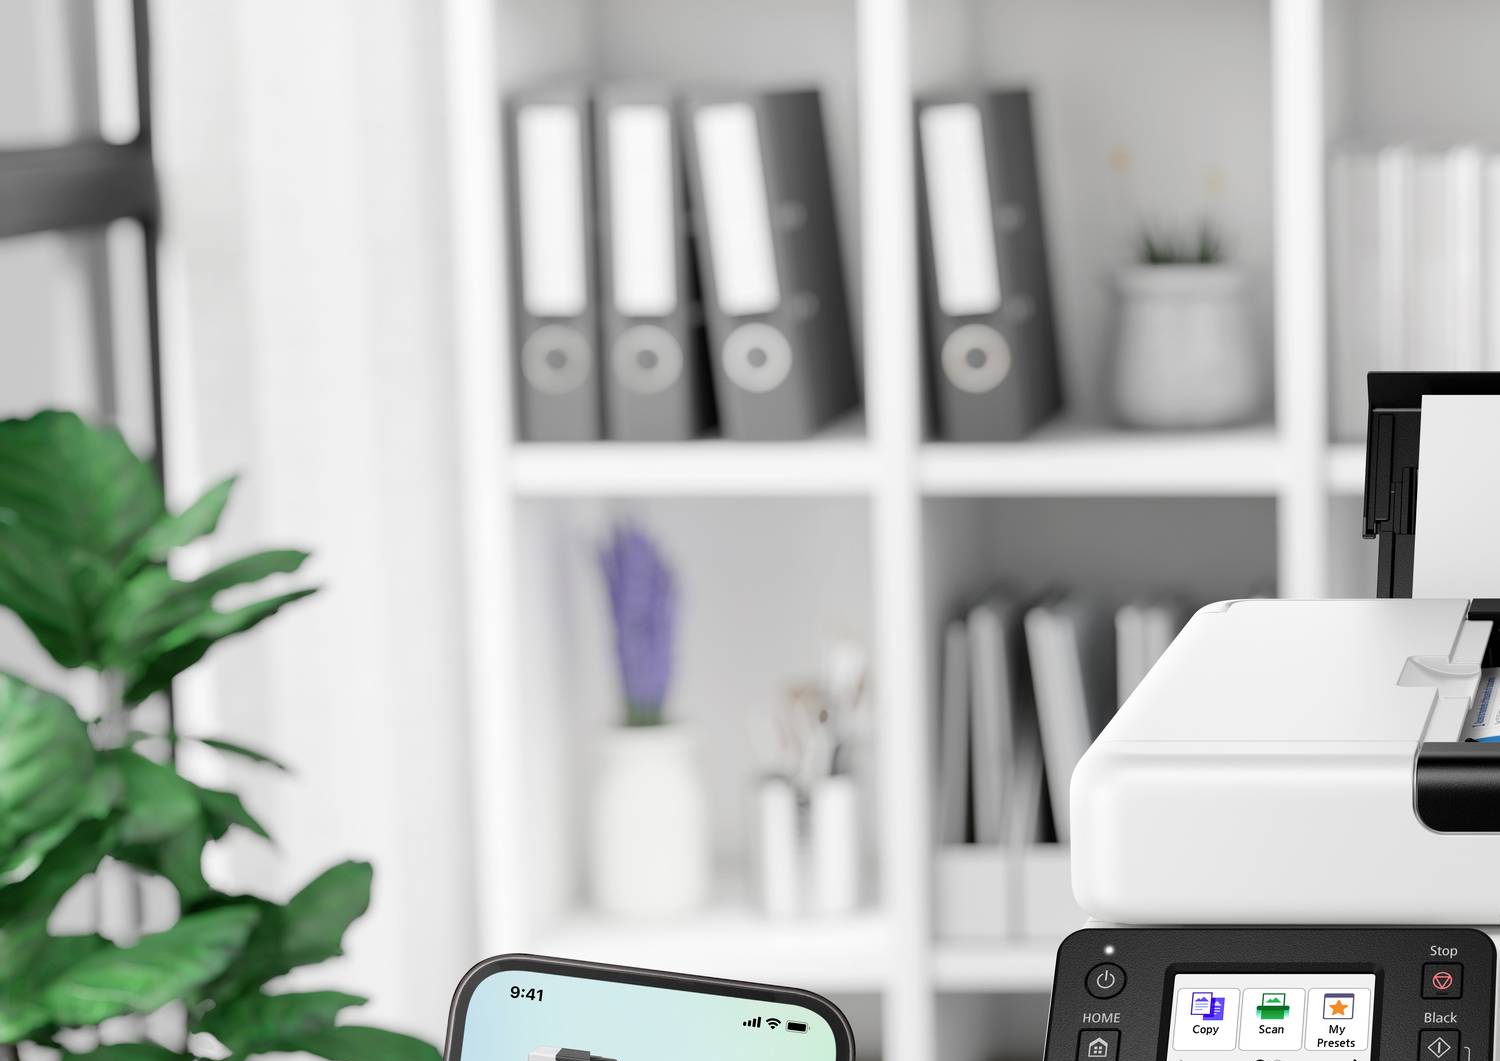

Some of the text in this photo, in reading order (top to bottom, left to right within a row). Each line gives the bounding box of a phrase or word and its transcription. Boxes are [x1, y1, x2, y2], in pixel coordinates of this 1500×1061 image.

[1430, 945, 1458, 958] Stop
[510, 986, 544, 1002] 9:41
[1082, 1012, 1121, 1023] HOME
[1424, 1012, 1457, 1023] Black
[1192, 1024, 1220, 1037] Copy
[1258, 1024, 1284, 1035] Scan
[1328, 1024, 1345, 1037] My
[1317, 1038, 1356, 1049] Presets
